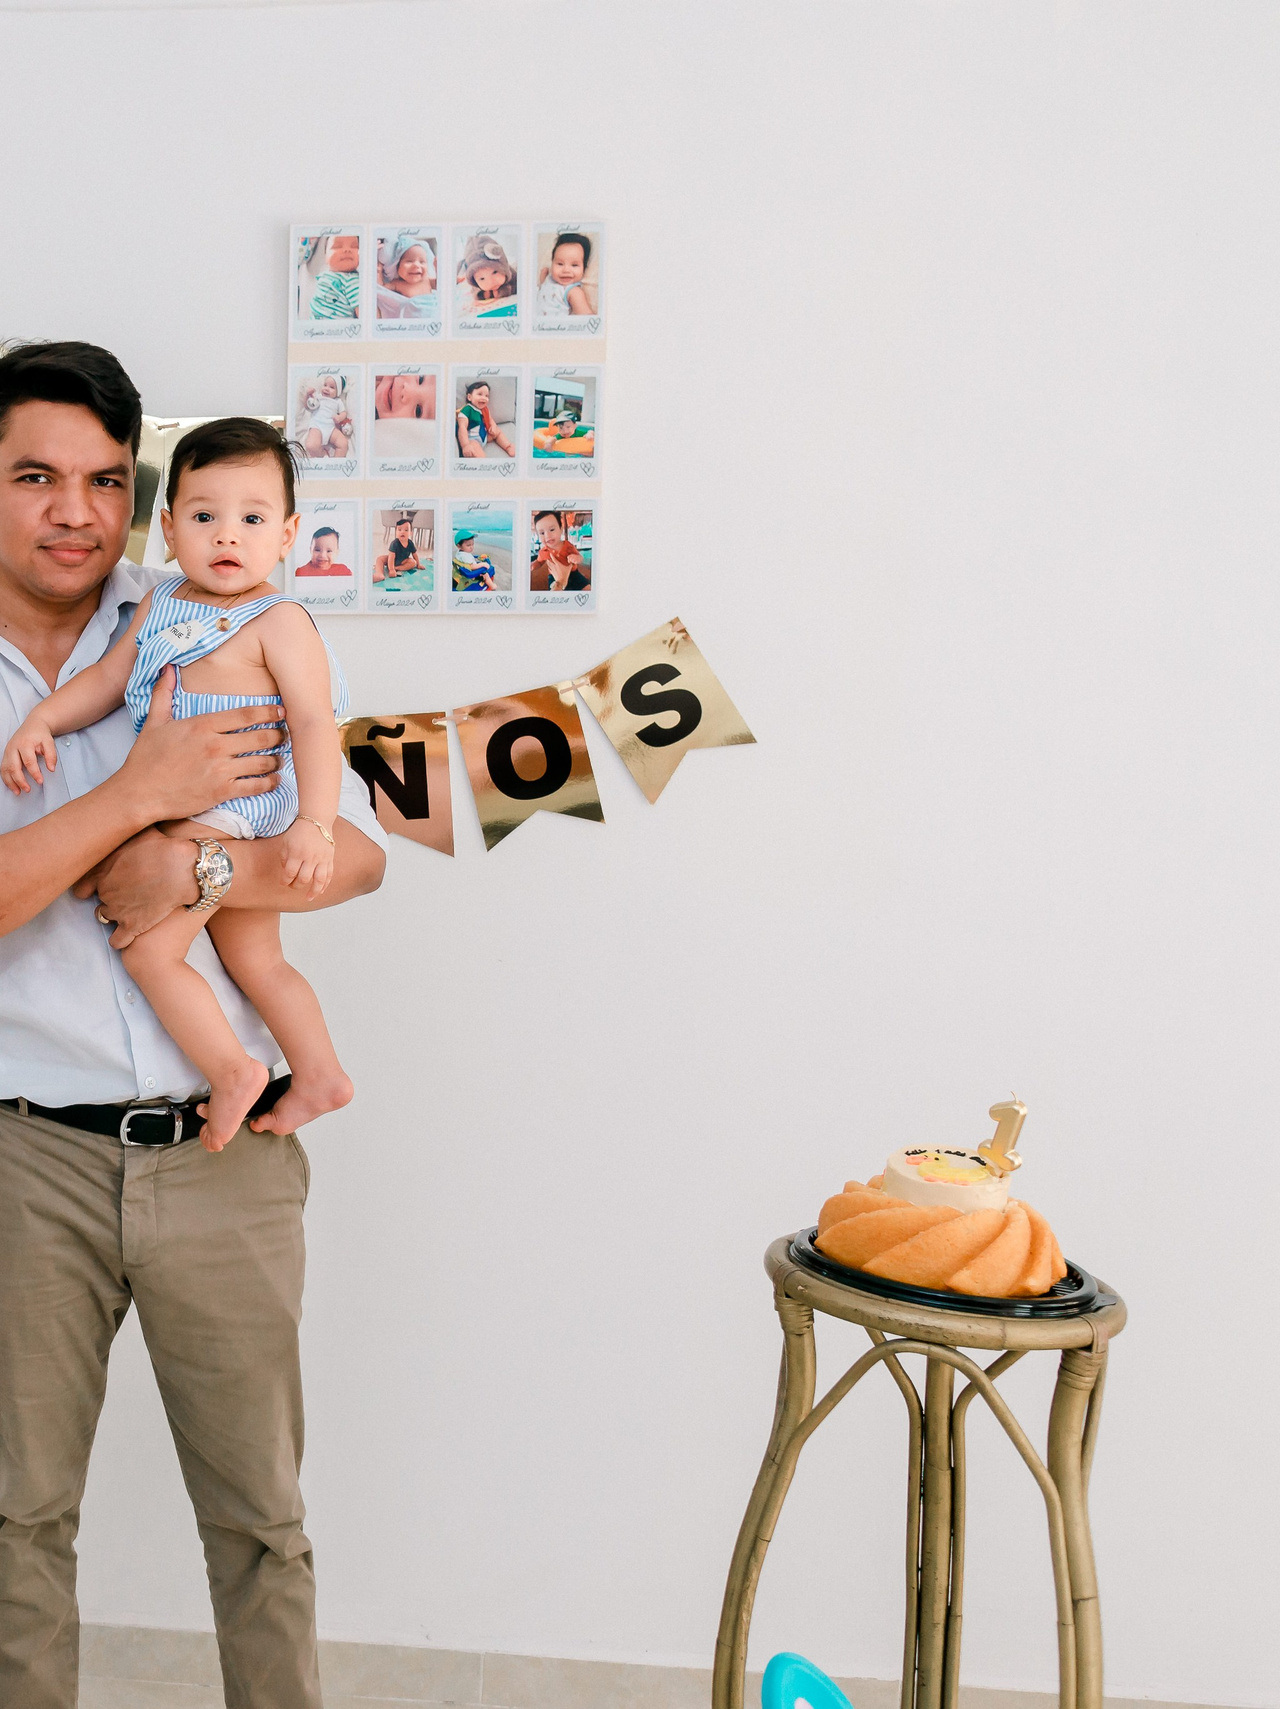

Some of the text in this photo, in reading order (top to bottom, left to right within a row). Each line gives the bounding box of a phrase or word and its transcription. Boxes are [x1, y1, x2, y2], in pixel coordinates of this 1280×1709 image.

[170, 626, 184, 639] TRUE
[349, 663, 703, 822] ÑOS
[977, 1099, 1028, 1171] 1
